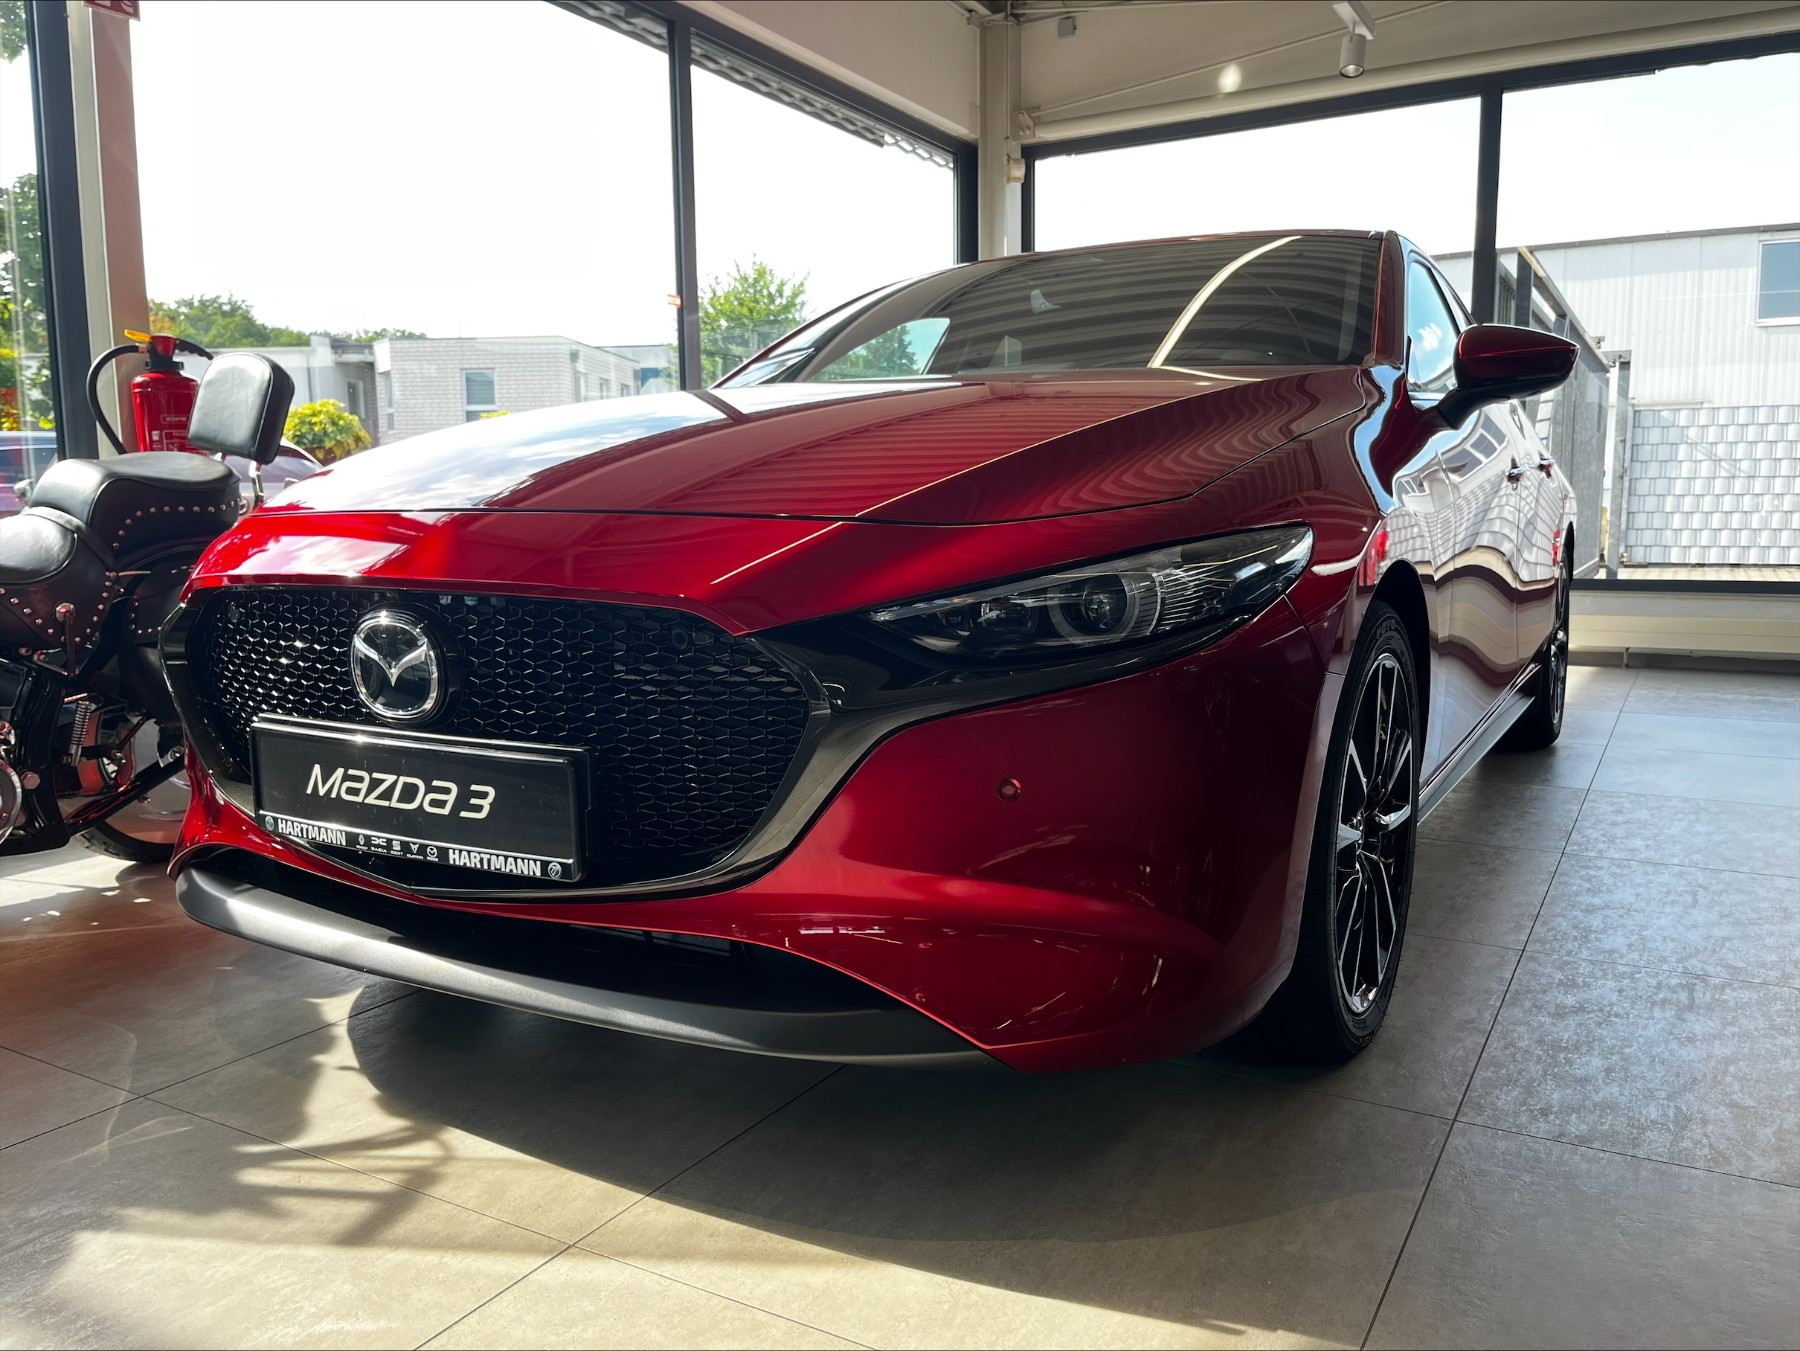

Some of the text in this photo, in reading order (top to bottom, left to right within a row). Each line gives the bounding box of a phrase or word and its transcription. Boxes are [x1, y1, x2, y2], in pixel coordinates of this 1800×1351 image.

[459, 784, 496, 820] 3
[278, 818, 346, 846] HARTMANN
[448, 848, 541, 877] HARTMANN
